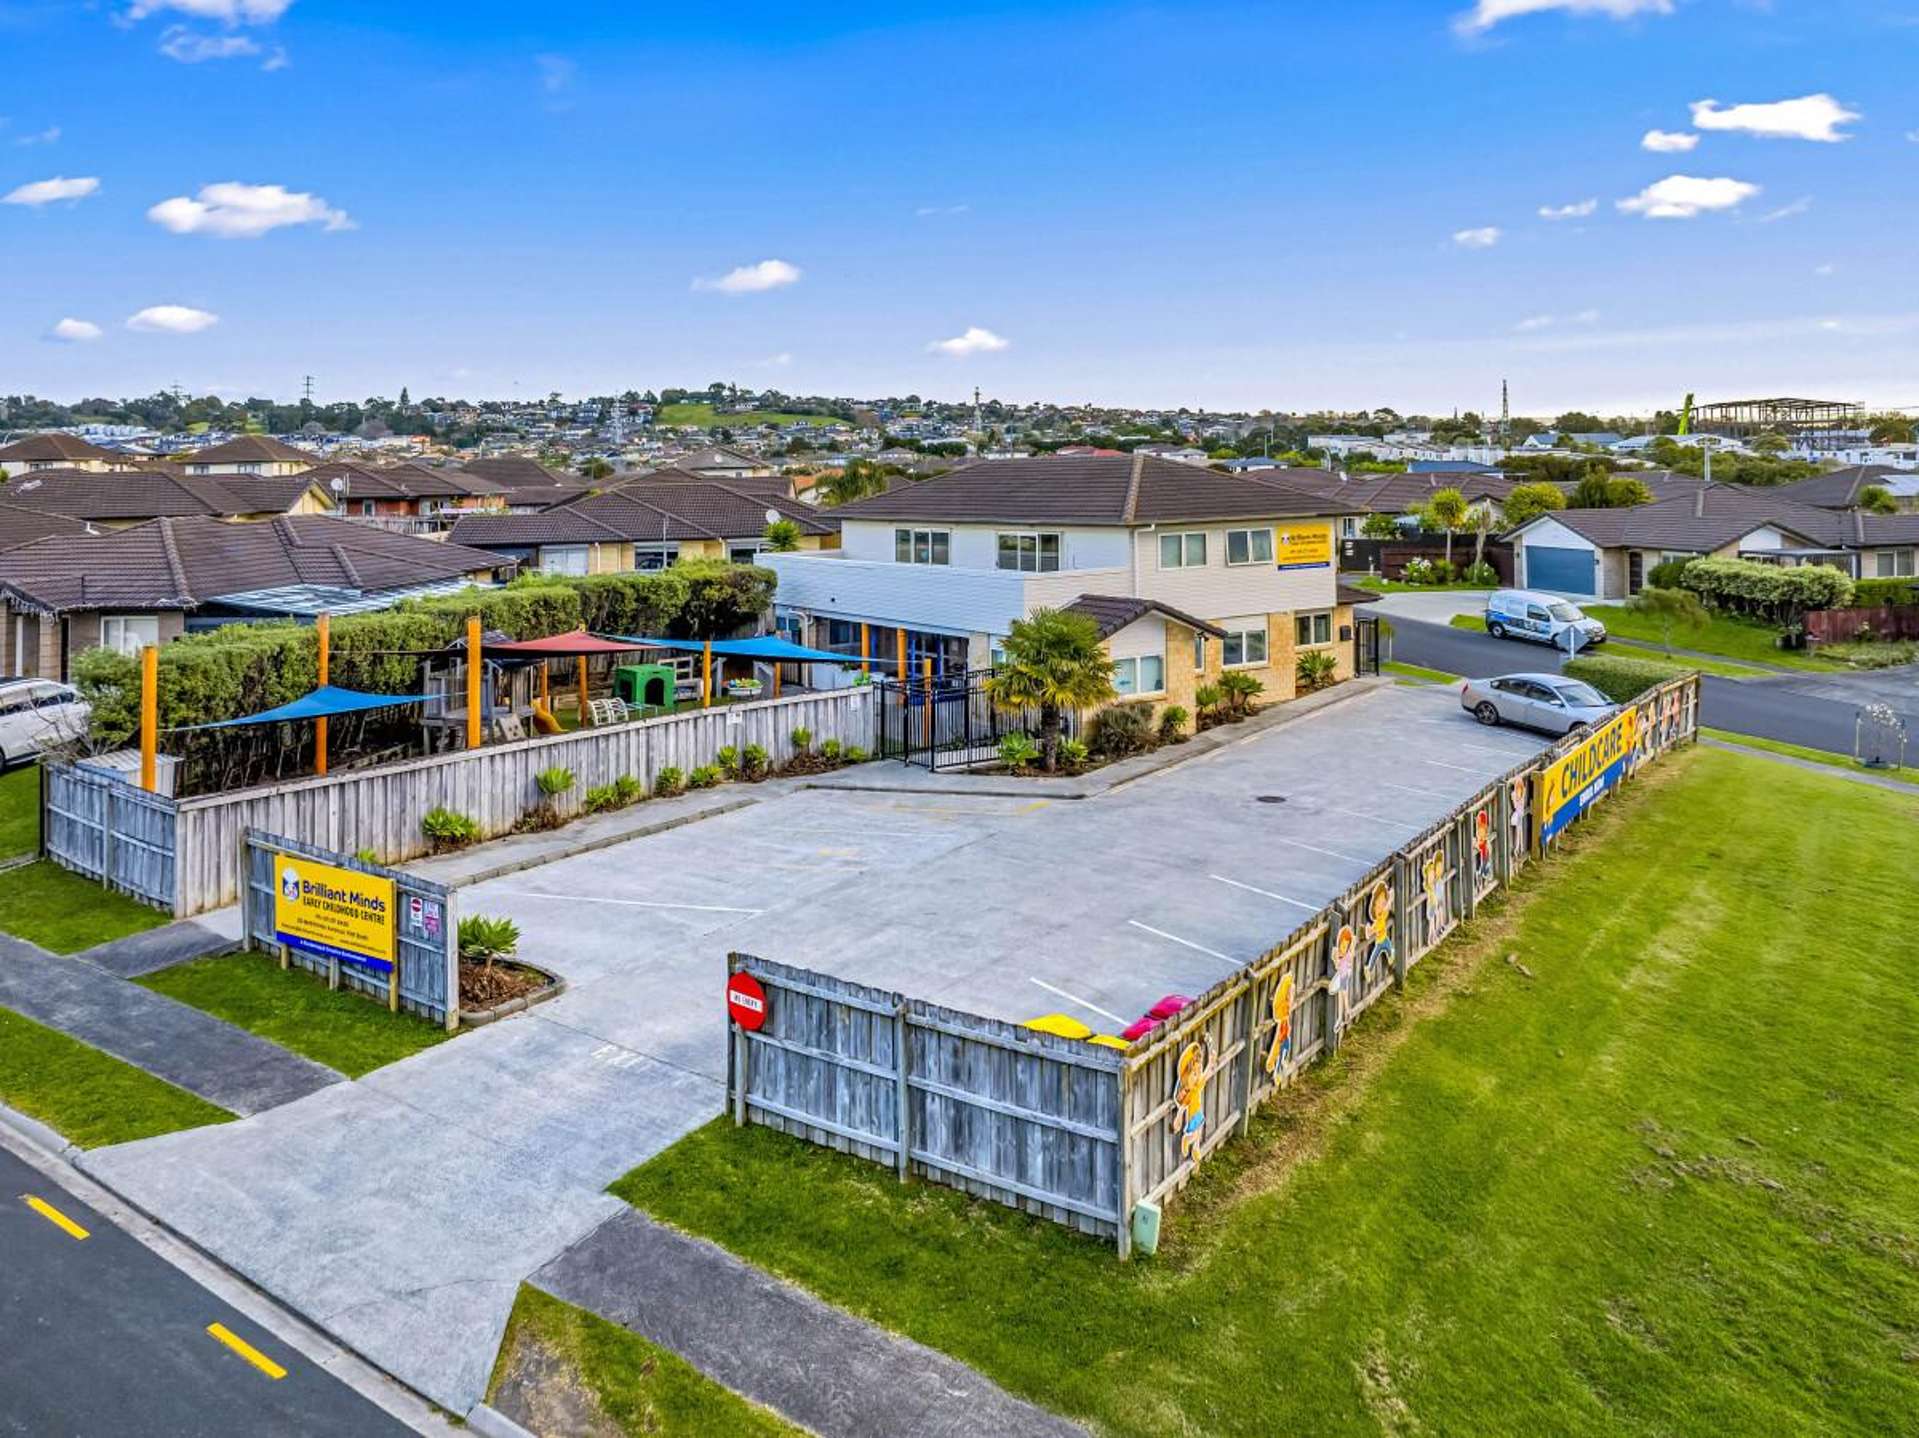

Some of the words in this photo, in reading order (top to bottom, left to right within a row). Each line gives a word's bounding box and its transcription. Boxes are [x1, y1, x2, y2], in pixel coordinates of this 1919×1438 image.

[1561, 721, 1623, 798] CHILDCARE
[303, 880, 346, 903] Brilliant
[350, 890, 386, 912] Minds
[303, 896, 321, 908] EARLY
[322, 900, 358, 918] CHILDHOOD
[361, 909, 385, 925] CENTRE
